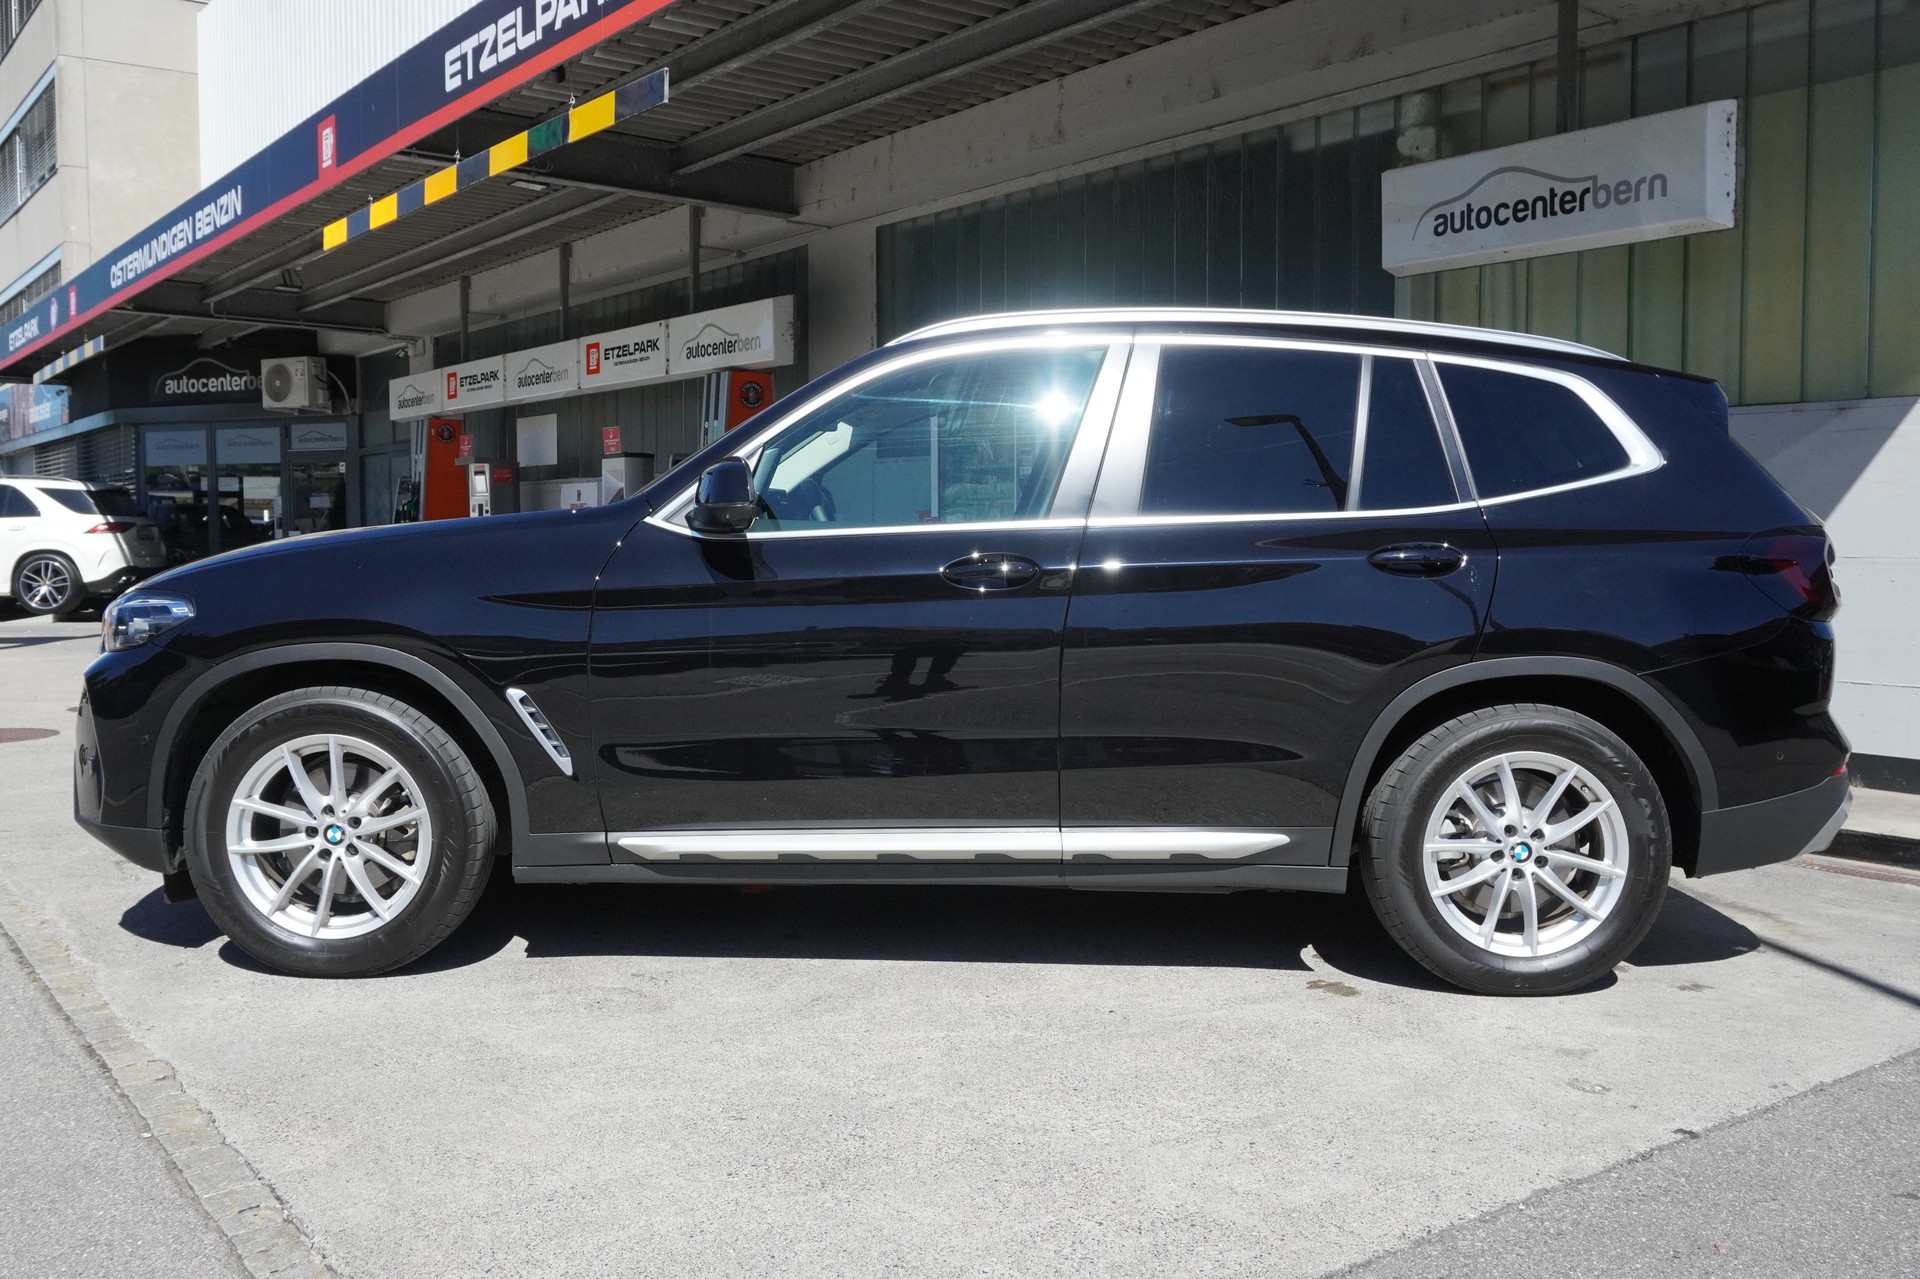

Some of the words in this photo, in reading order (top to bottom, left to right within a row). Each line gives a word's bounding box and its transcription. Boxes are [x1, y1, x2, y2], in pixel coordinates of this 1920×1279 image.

[445, 0, 609, 93] ETZELPA
[1433, 173, 1668, 237] autocenterbern
[110, 216, 193, 289] OSTERMUNDIGEN
[195, 184, 242, 240] BENZIN
[9, 315, 40, 351] ETZELPARK
[686, 333, 761, 360] autocenterbern
[604, 337, 660, 361] ETZELPARK
[460, 369, 500, 388] ETZELPARK
[517, 366, 569, 388] autocenterbern
